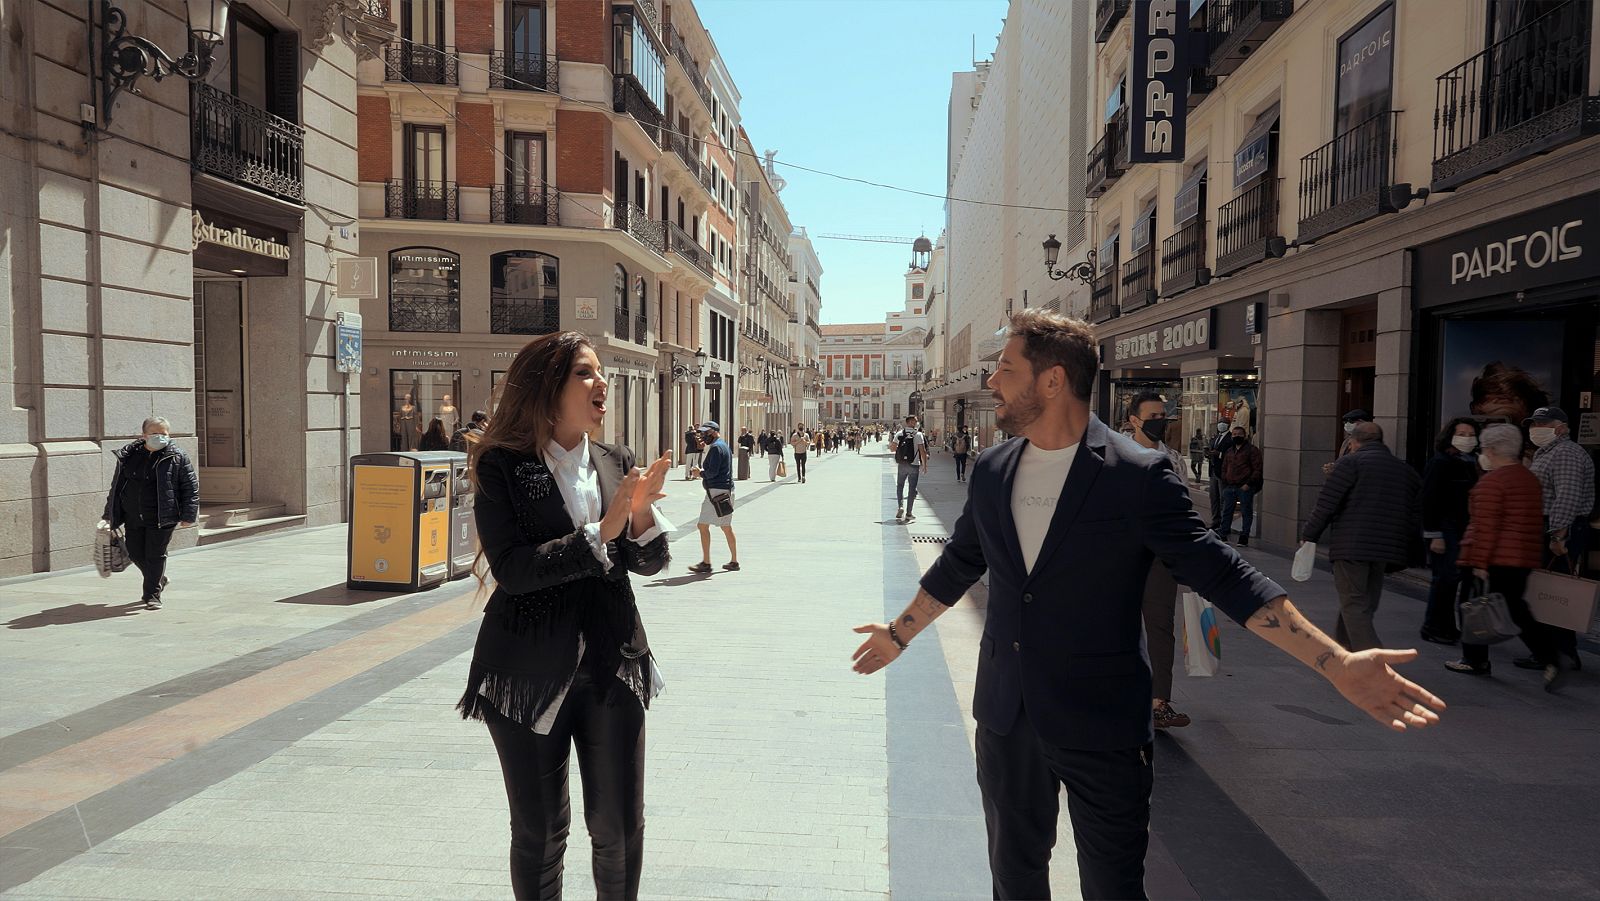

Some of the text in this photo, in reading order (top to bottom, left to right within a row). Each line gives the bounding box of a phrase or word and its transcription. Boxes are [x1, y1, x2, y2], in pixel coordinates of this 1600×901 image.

[1340, 30, 1391, 79] PARFOIS
[201, 221, 291, 261] stradivarius
[398, 255, 453, 263] intimissimi
[1451, 219, 1583, 285] PARFOIS
[391, 350, 458, 358] intimissimi
[1115, 317, 1208, 361] SPORT 2000
